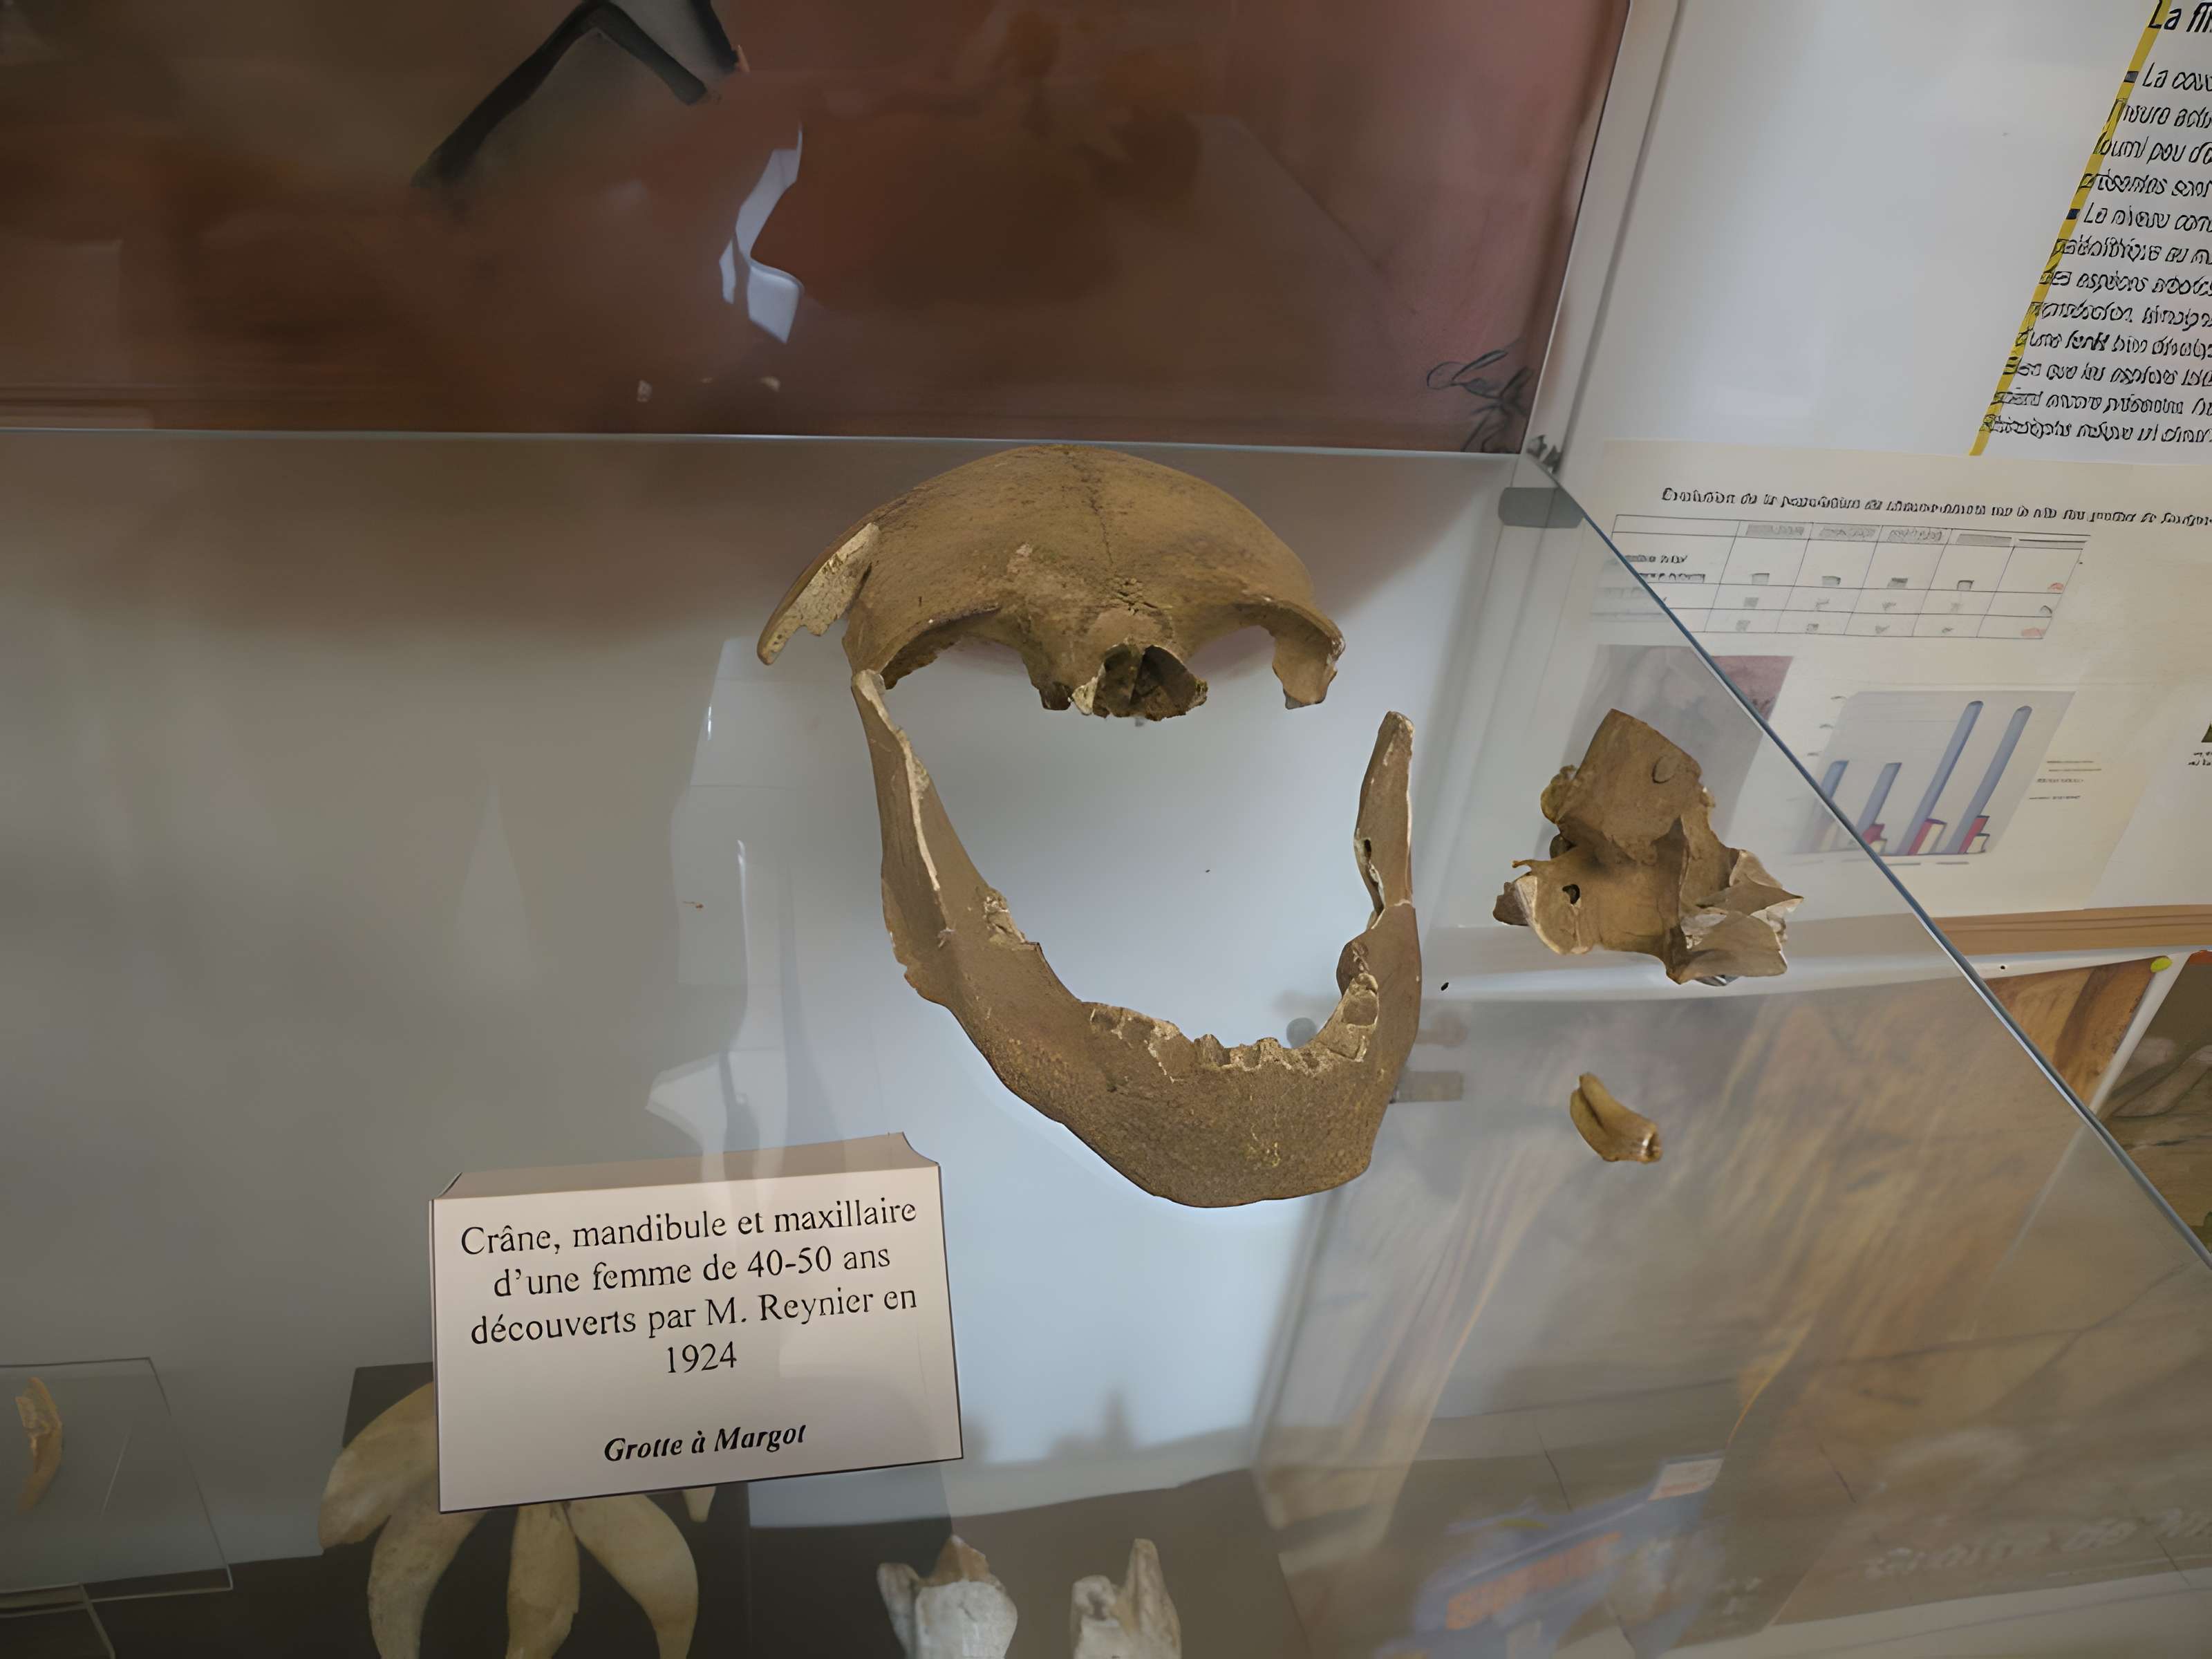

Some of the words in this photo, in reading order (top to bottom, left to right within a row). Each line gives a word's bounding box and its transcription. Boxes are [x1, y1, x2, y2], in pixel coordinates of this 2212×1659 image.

[461, 1225, 561, 1255] Crâne,
[572, 1211, 727, 1248] mandibule
[738, 1212, 765, 1235] et
[774, 1197, 917, 1232] maxillaire
[592, 1261, 691, 1291] femme
[702, 1253, 738, 1282] de
[747, 1245, 832, 1278] 40-50
[843, 1248, 890, 1271] ans
[471, 1311, 637, 1344] découverts
[648, 1309, 696, 1339] par
[704, 1296, 747, 1326] M.
[757, 1286, 874, 1325] Reynier
[883, 1289, 917, 1311] en
[667, 1340, 738, 1374] 1924
[604, 1437, 683, 1462] Grotte
[691, 1430, 706, 1454] à
[714, 1424, 807, 1453] Margot
